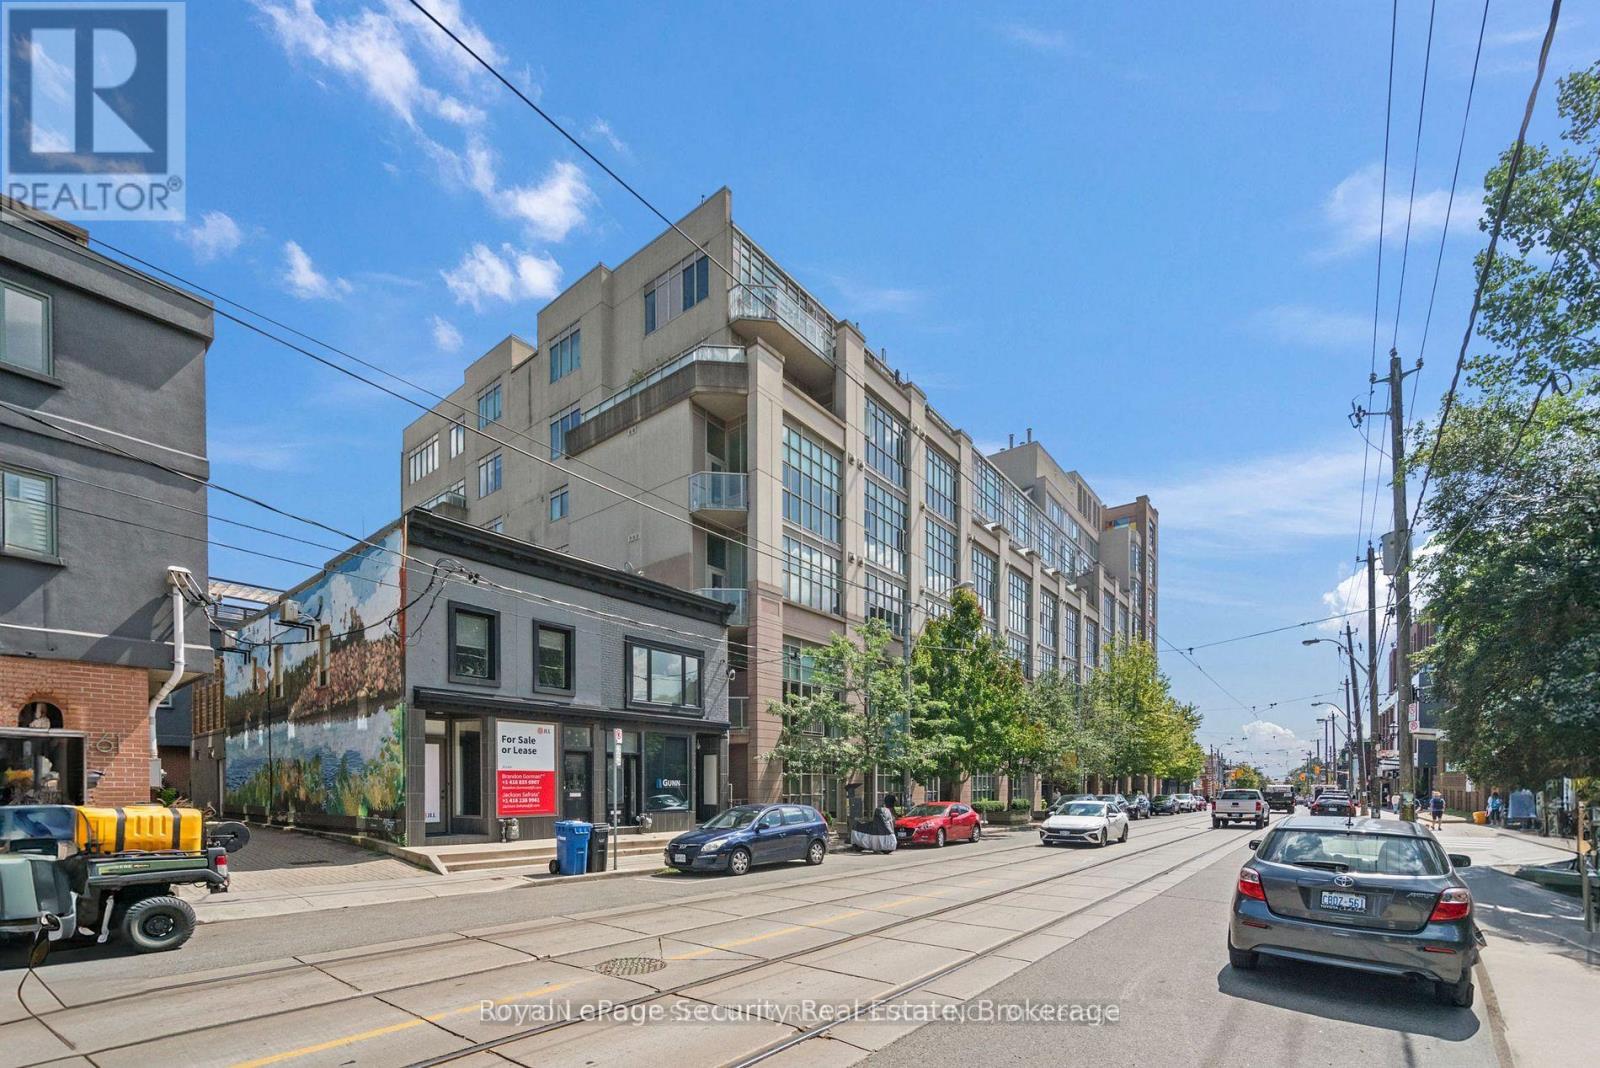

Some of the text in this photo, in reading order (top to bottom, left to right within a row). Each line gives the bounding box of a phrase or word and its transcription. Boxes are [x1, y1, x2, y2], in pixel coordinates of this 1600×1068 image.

[501, 735, 537, 745] For Sale
[513, 746, 537, 755] Lease
[662, 778, 681, 787] GUNN
